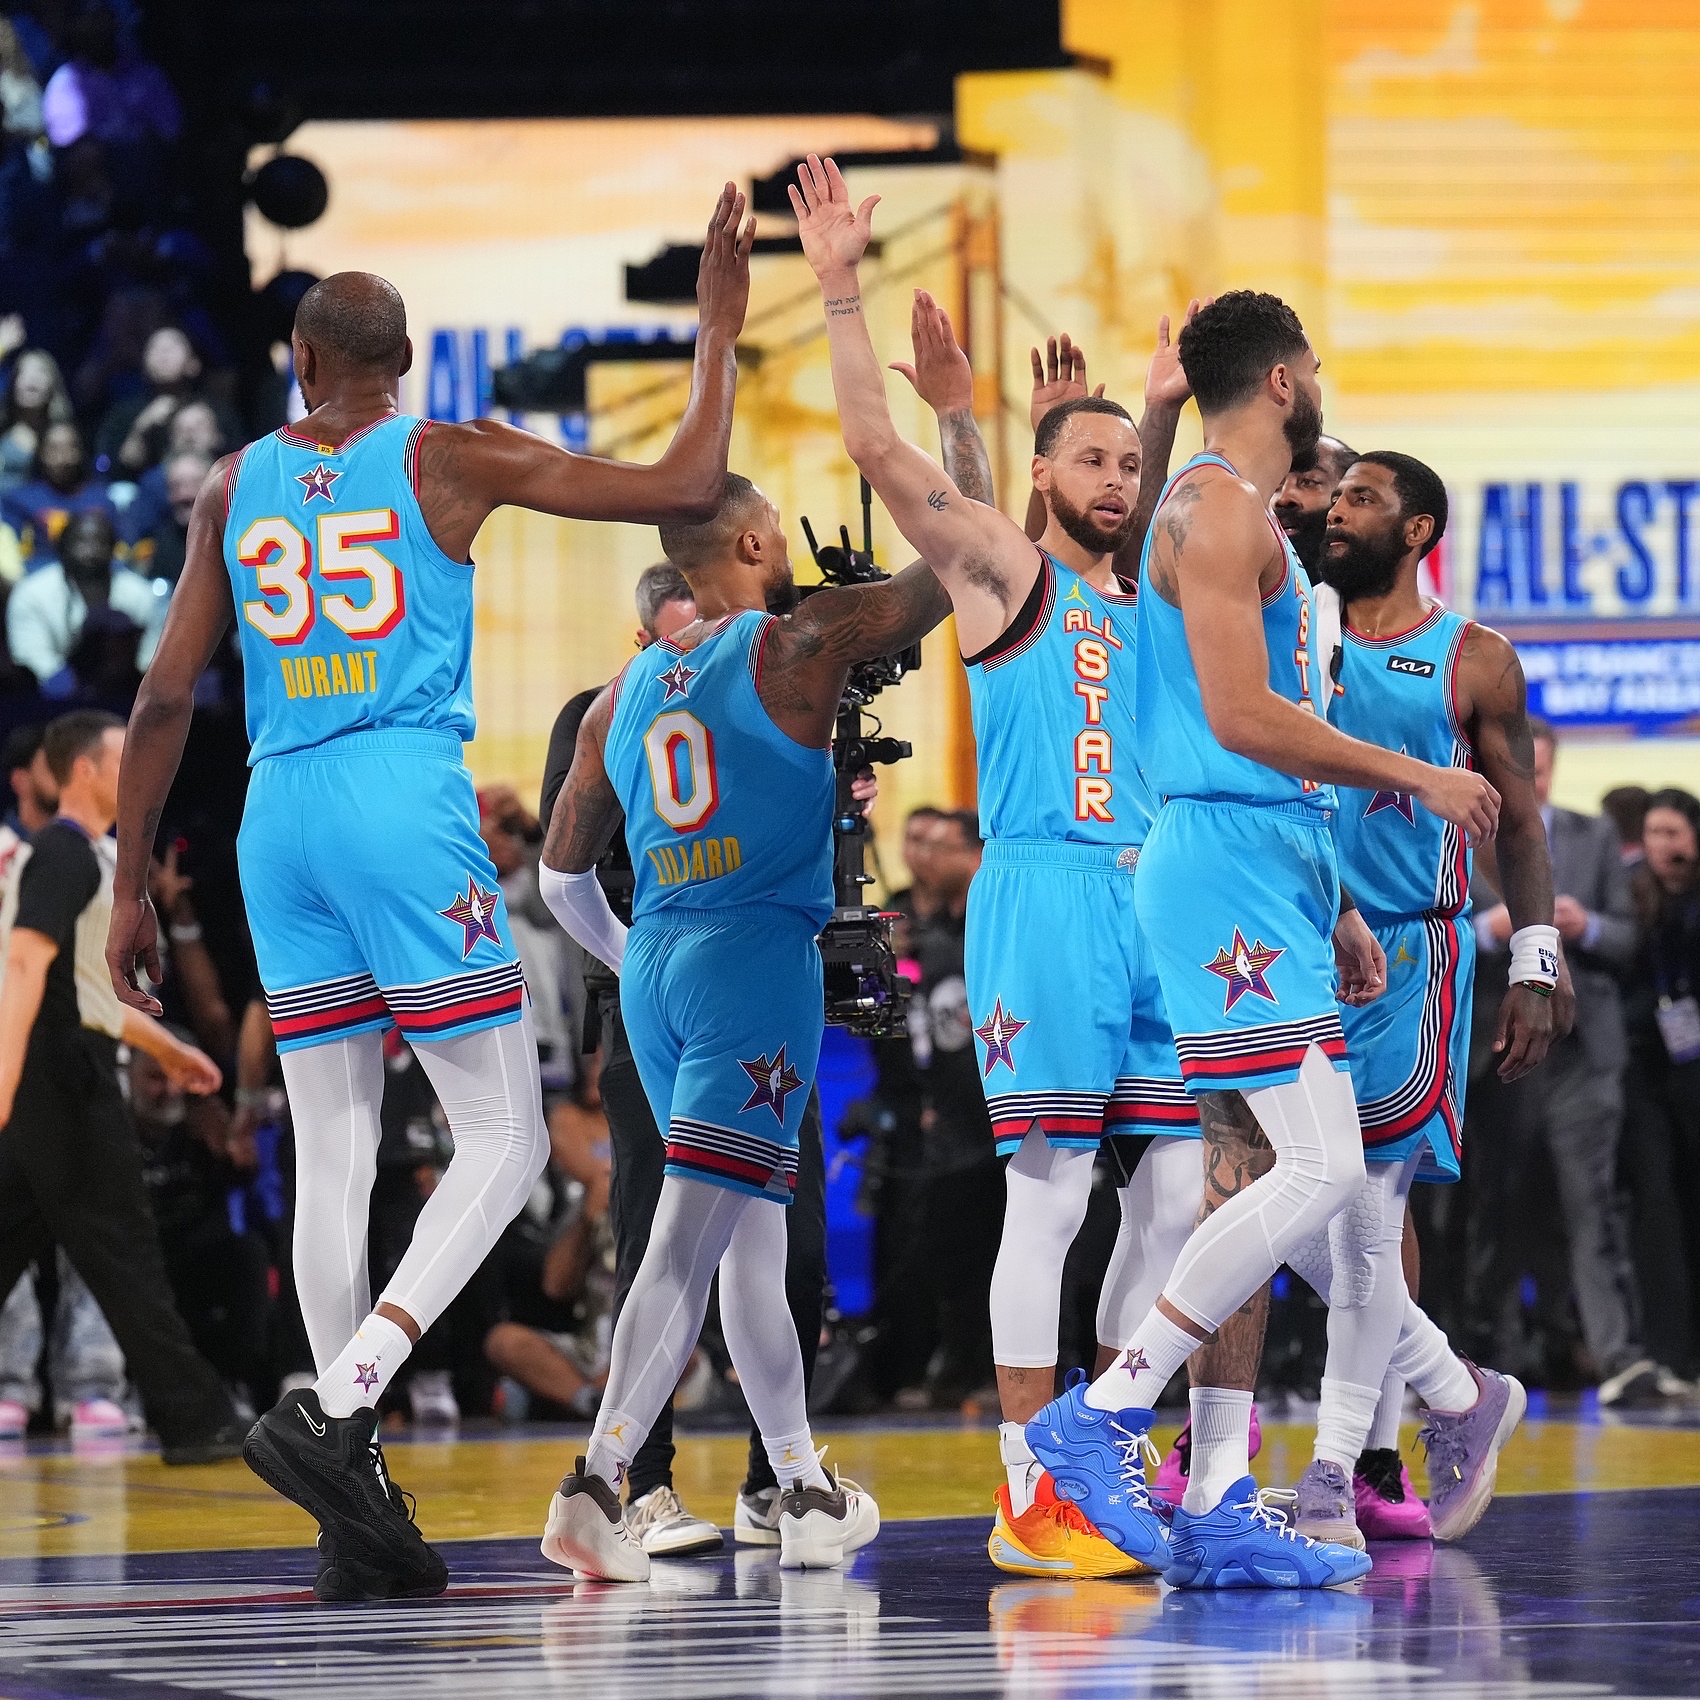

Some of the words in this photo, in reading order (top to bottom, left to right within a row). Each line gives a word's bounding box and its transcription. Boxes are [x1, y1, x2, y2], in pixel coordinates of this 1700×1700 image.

[237, 508, 406, 647] 35
[1064, 608, 1122, 650] ALL
[280, 651, 378, 699] DURANT
[643, 709, 720, 834] 0
[1074, 637, 1115, 822] STAR
[647, 836, 742, 886] LILLARD
